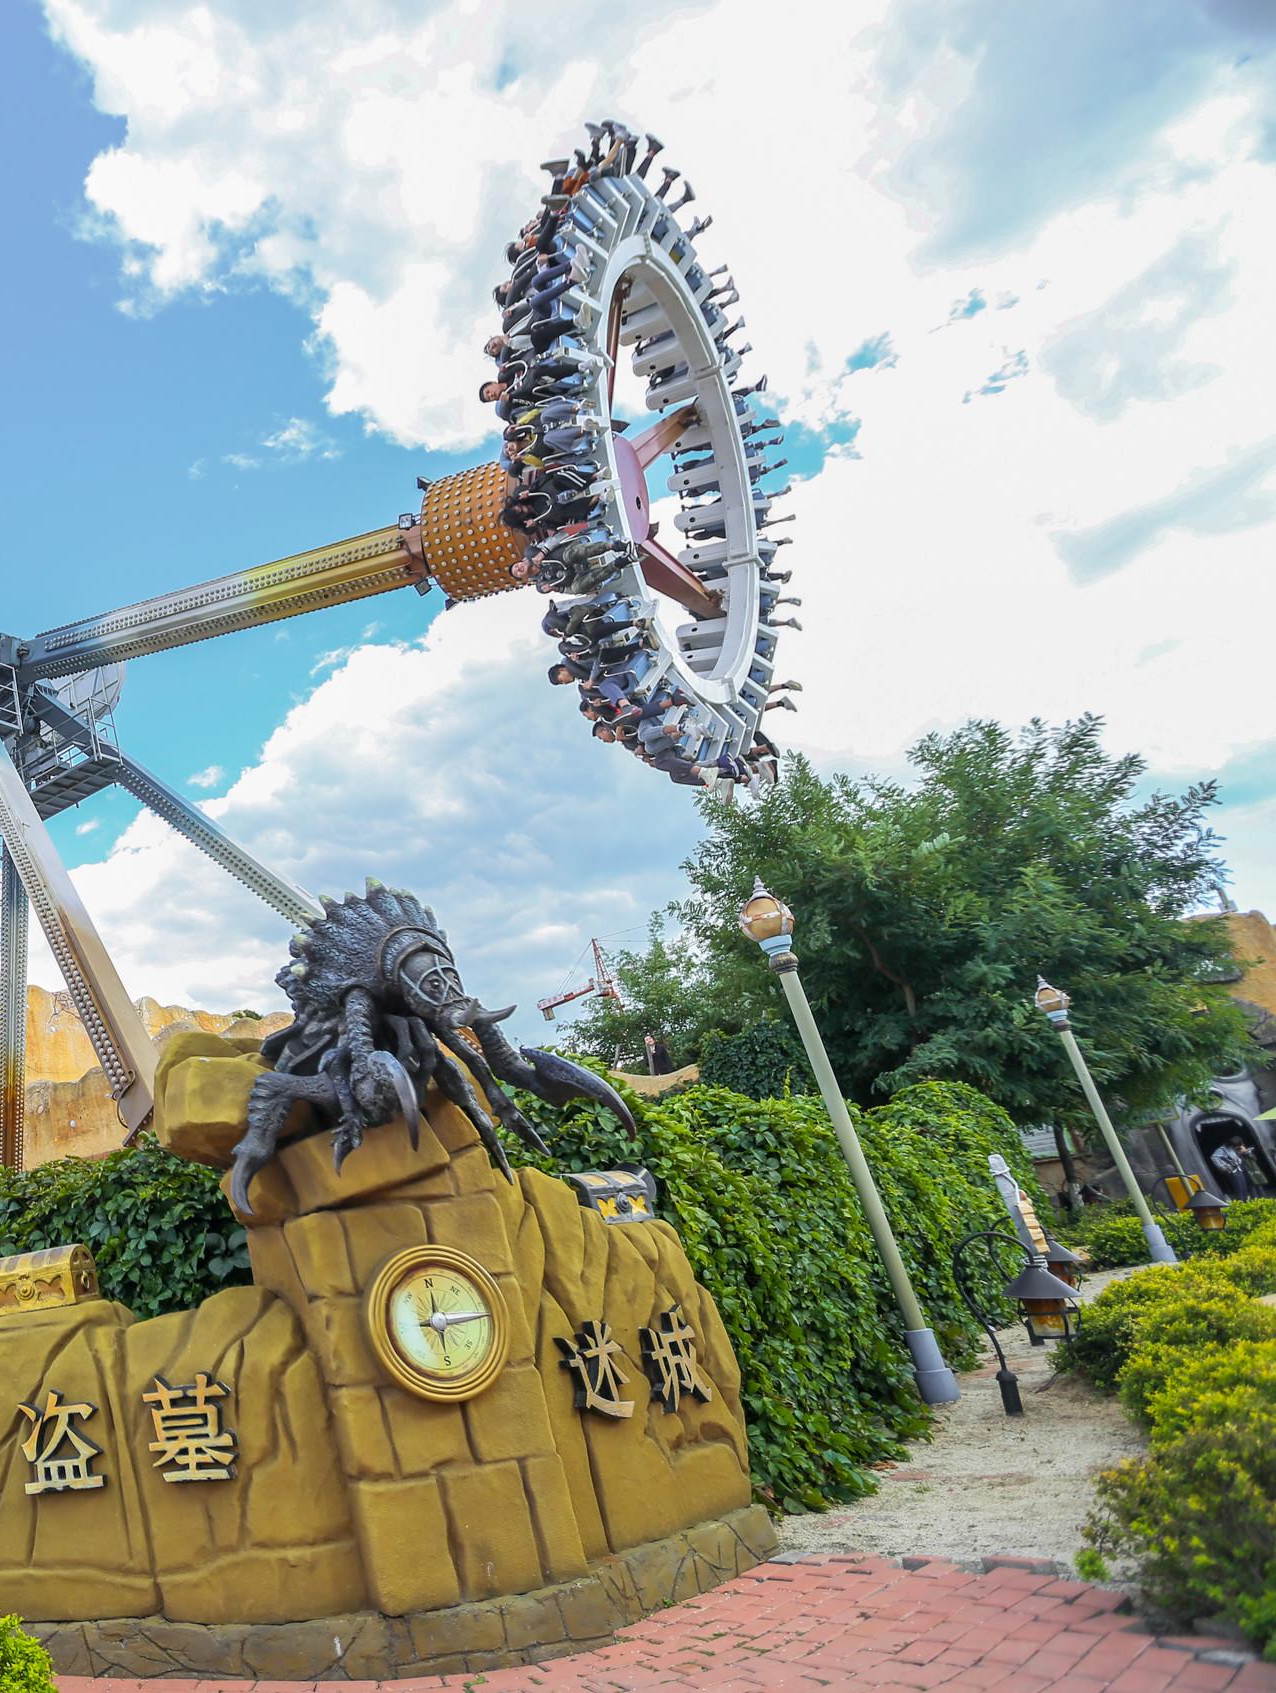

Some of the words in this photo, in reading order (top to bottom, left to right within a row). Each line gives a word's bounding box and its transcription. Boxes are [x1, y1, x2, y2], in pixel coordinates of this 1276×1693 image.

[424, 1278, 434, 1289] N
[449, 1285, 461, 1296] NE
[443, 1355, 452, 1366] S
[18, 1371, 238, 1495] 盗墓
[553, 1304, 712, 1417] 迷城
